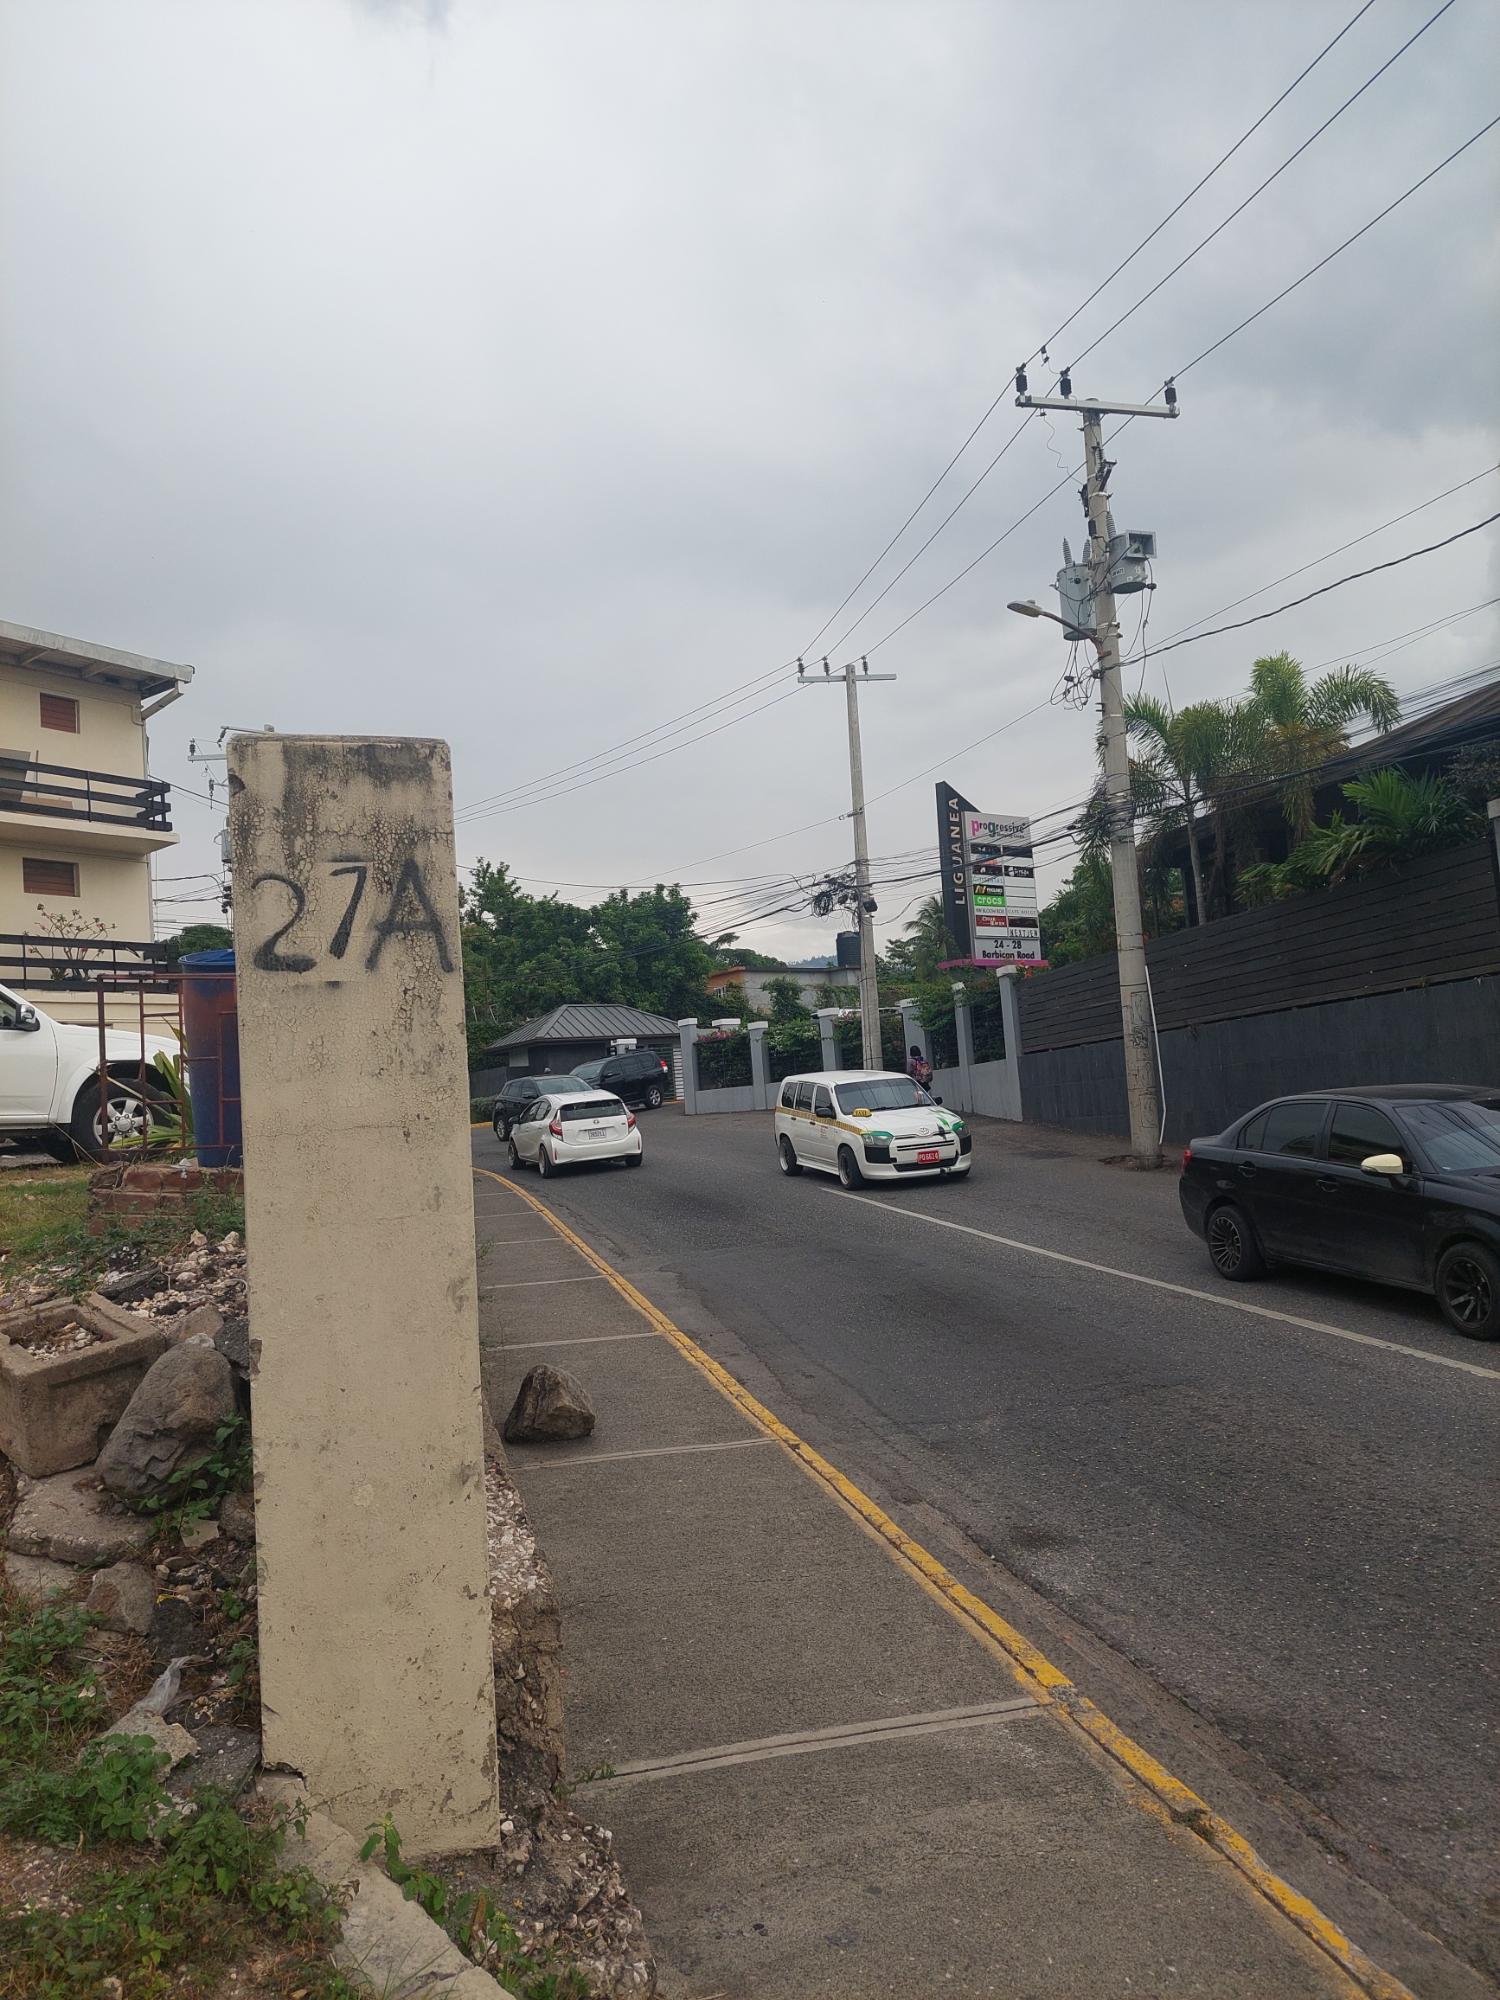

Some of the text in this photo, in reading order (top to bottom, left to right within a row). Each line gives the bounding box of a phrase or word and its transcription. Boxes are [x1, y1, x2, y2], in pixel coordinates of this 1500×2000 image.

[948, 798, 966, 905] LIGUANEA
[977, 896, 1002, 905] crocs
[251, 859, 454, 974] 27A
[993, 940, 1004, 949] 24
[1012, 940, 1022, 949] 28
[982, 950, 1035, 959] Barbican Road
